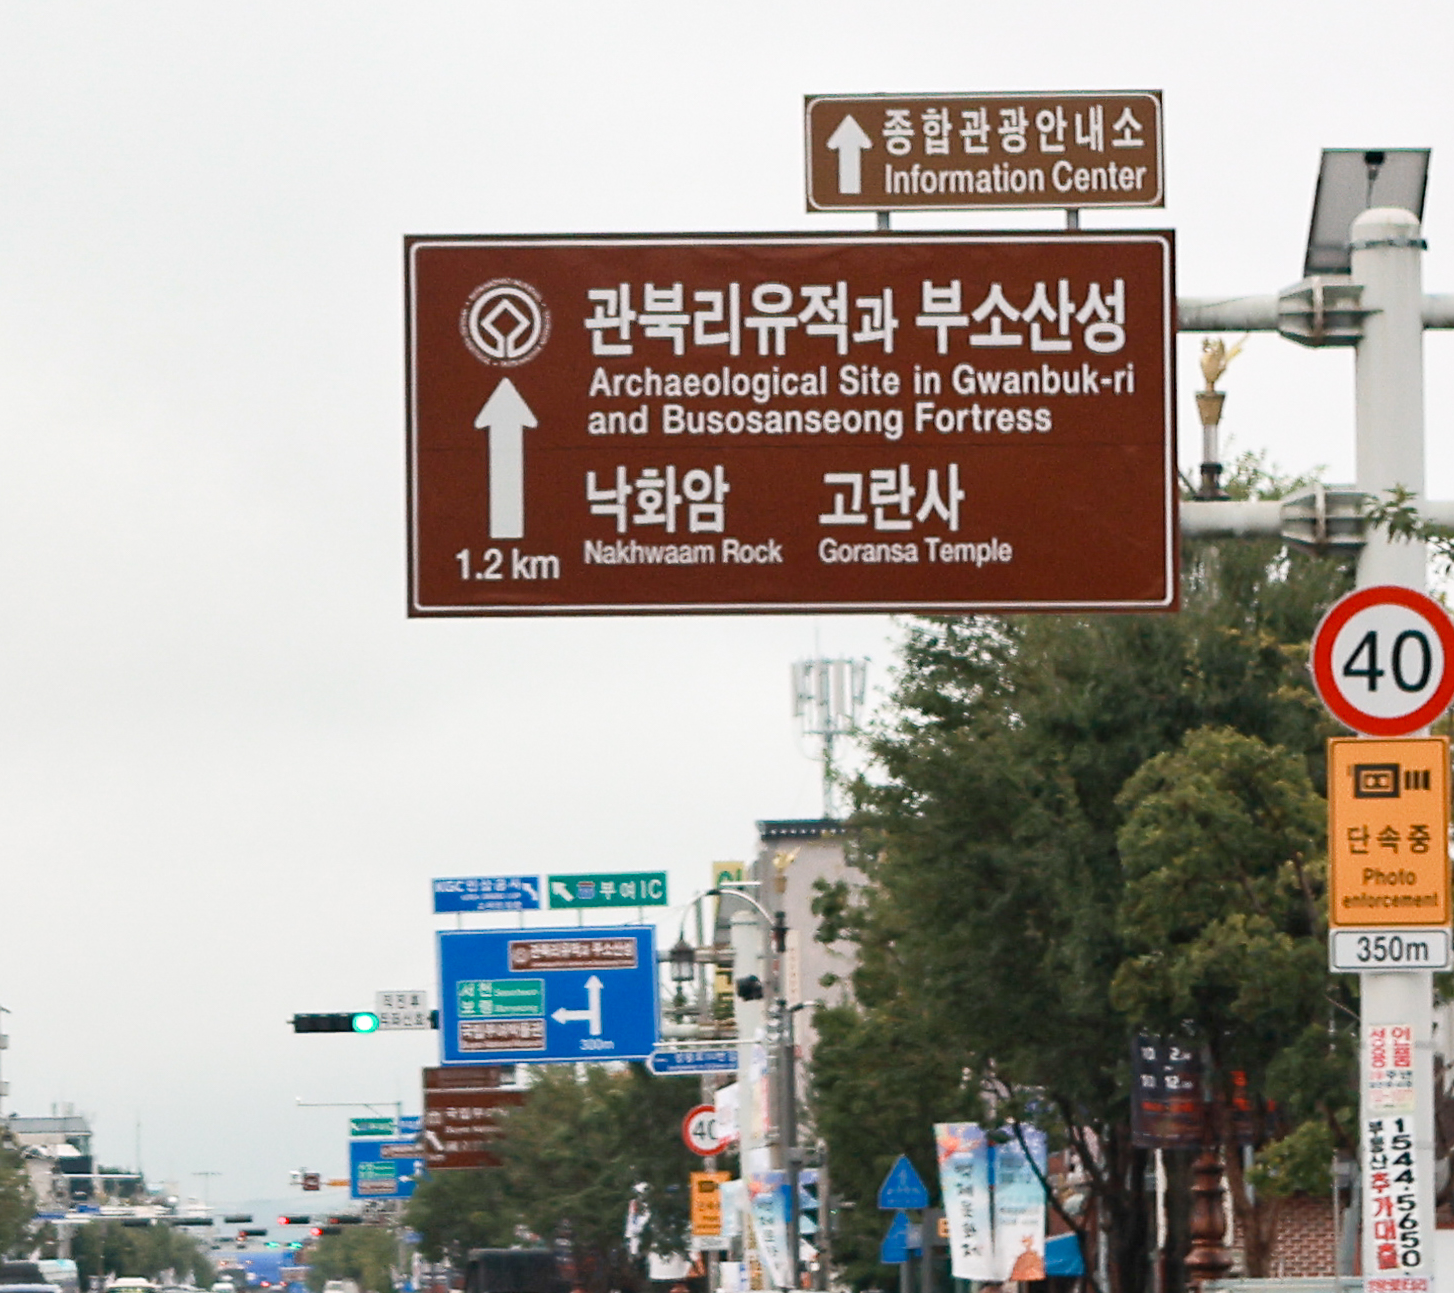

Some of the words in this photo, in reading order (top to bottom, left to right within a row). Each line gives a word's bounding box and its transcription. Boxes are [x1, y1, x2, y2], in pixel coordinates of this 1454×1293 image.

[882, 104, 1144, 157] 종합관광안내소
[885, 163, 1045, 195] Information
[1052, 160, 1147, 192] Center
[584, 281, 899, 356] 관북리유적과
[915, 278, 1126, 354] 부소산성
[588, 367, 827, 403] Archaeological
[839, 366, 899, 396] Site
[914, 365, 940, 394] in
[953, 363, 1134, 396] Gwanbuk-ri
[588, 405, 648, 435] and
[663, 404, 903, 440] Busosanseong
[916, 402, 1052, 433] Fortress
[586, 465, 730, 533] 낙화암
[819, 463, 965, 531] 고란사
[456, 550, 503, 581] 1.2
[512, 549, 560, 580] km
[584, 539, 717, 565] Nakhwaam
[723, 538, 782, 564] Rock
[819, 538, 918, 565] Goransa
[924, 537, 1011, 569] Temple
[1342, 629, 1432, 694] 40
[1347, 824, 1430, 855] 단속중
[1362, 868, 1418, 885] Photo
[1343, 892, 1439, 908] enforcement
[1356, 935, 1429, 963] 350m
